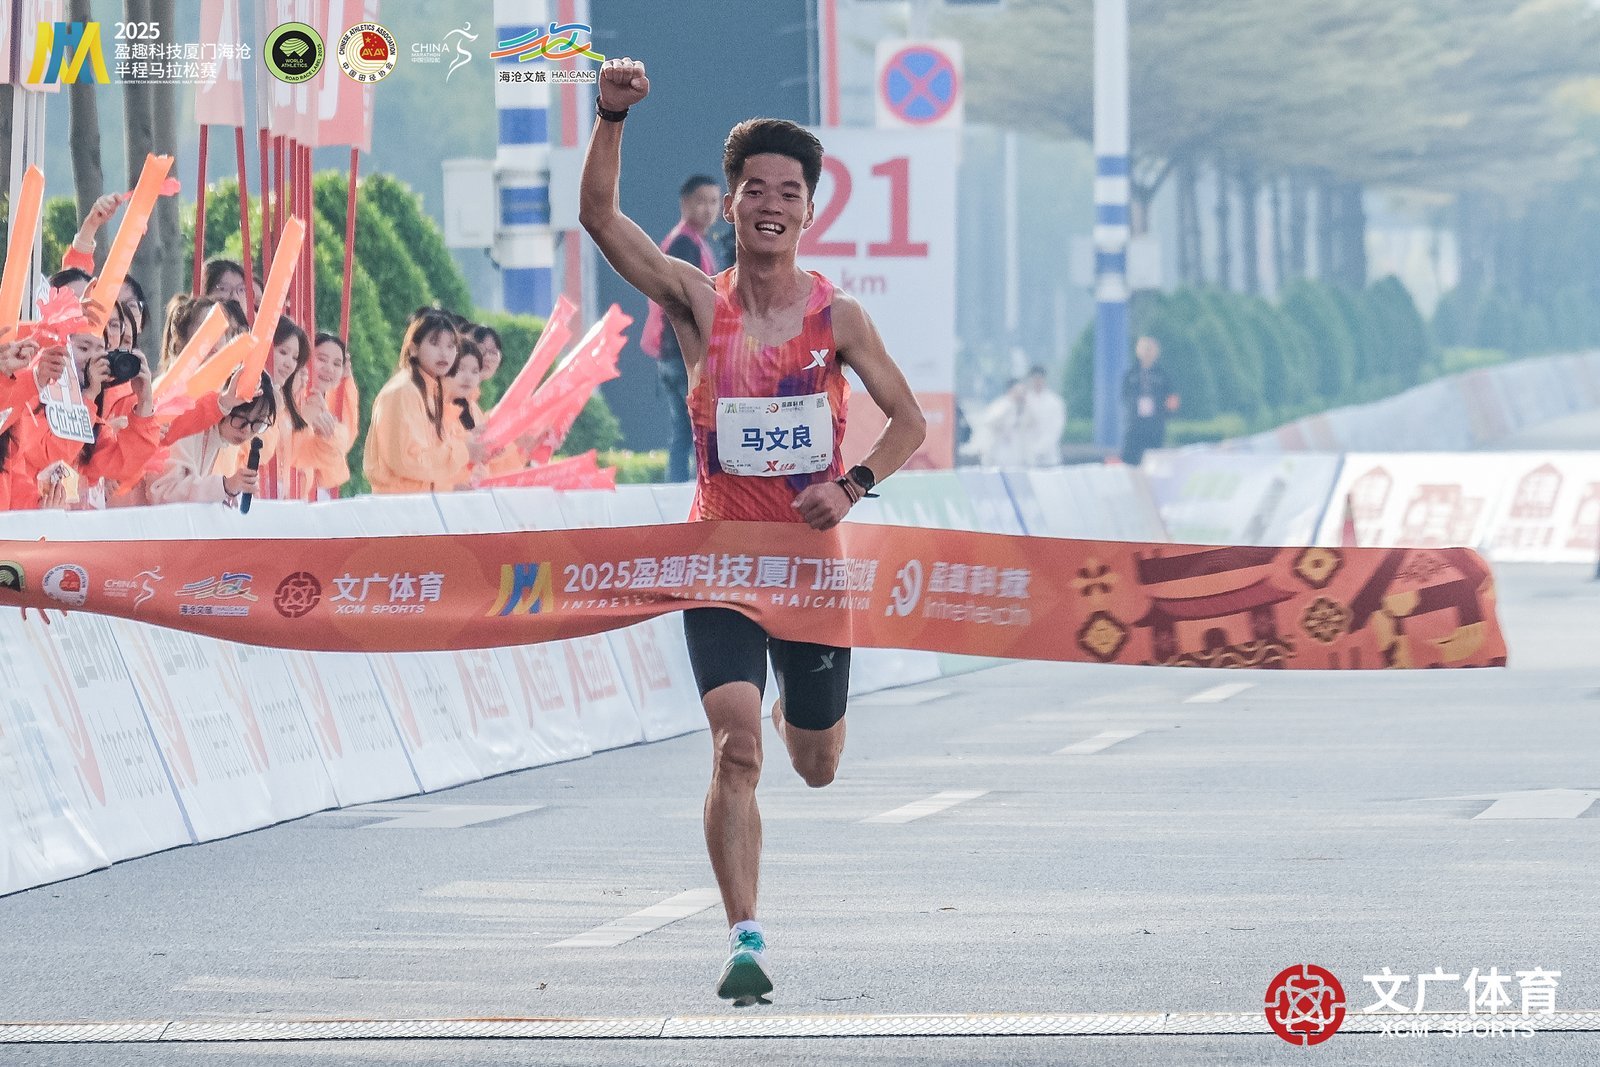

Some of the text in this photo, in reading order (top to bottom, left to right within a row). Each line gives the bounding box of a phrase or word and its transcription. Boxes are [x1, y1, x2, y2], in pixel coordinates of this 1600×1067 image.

[797, 156, 929, 258] 21
[840, 268, 889, 294] km
[741, 424, 813, 452] 马文良
[329, 571, 445, 602] 文广体育
[335, 604, 426, 614] XCM SPORTS
